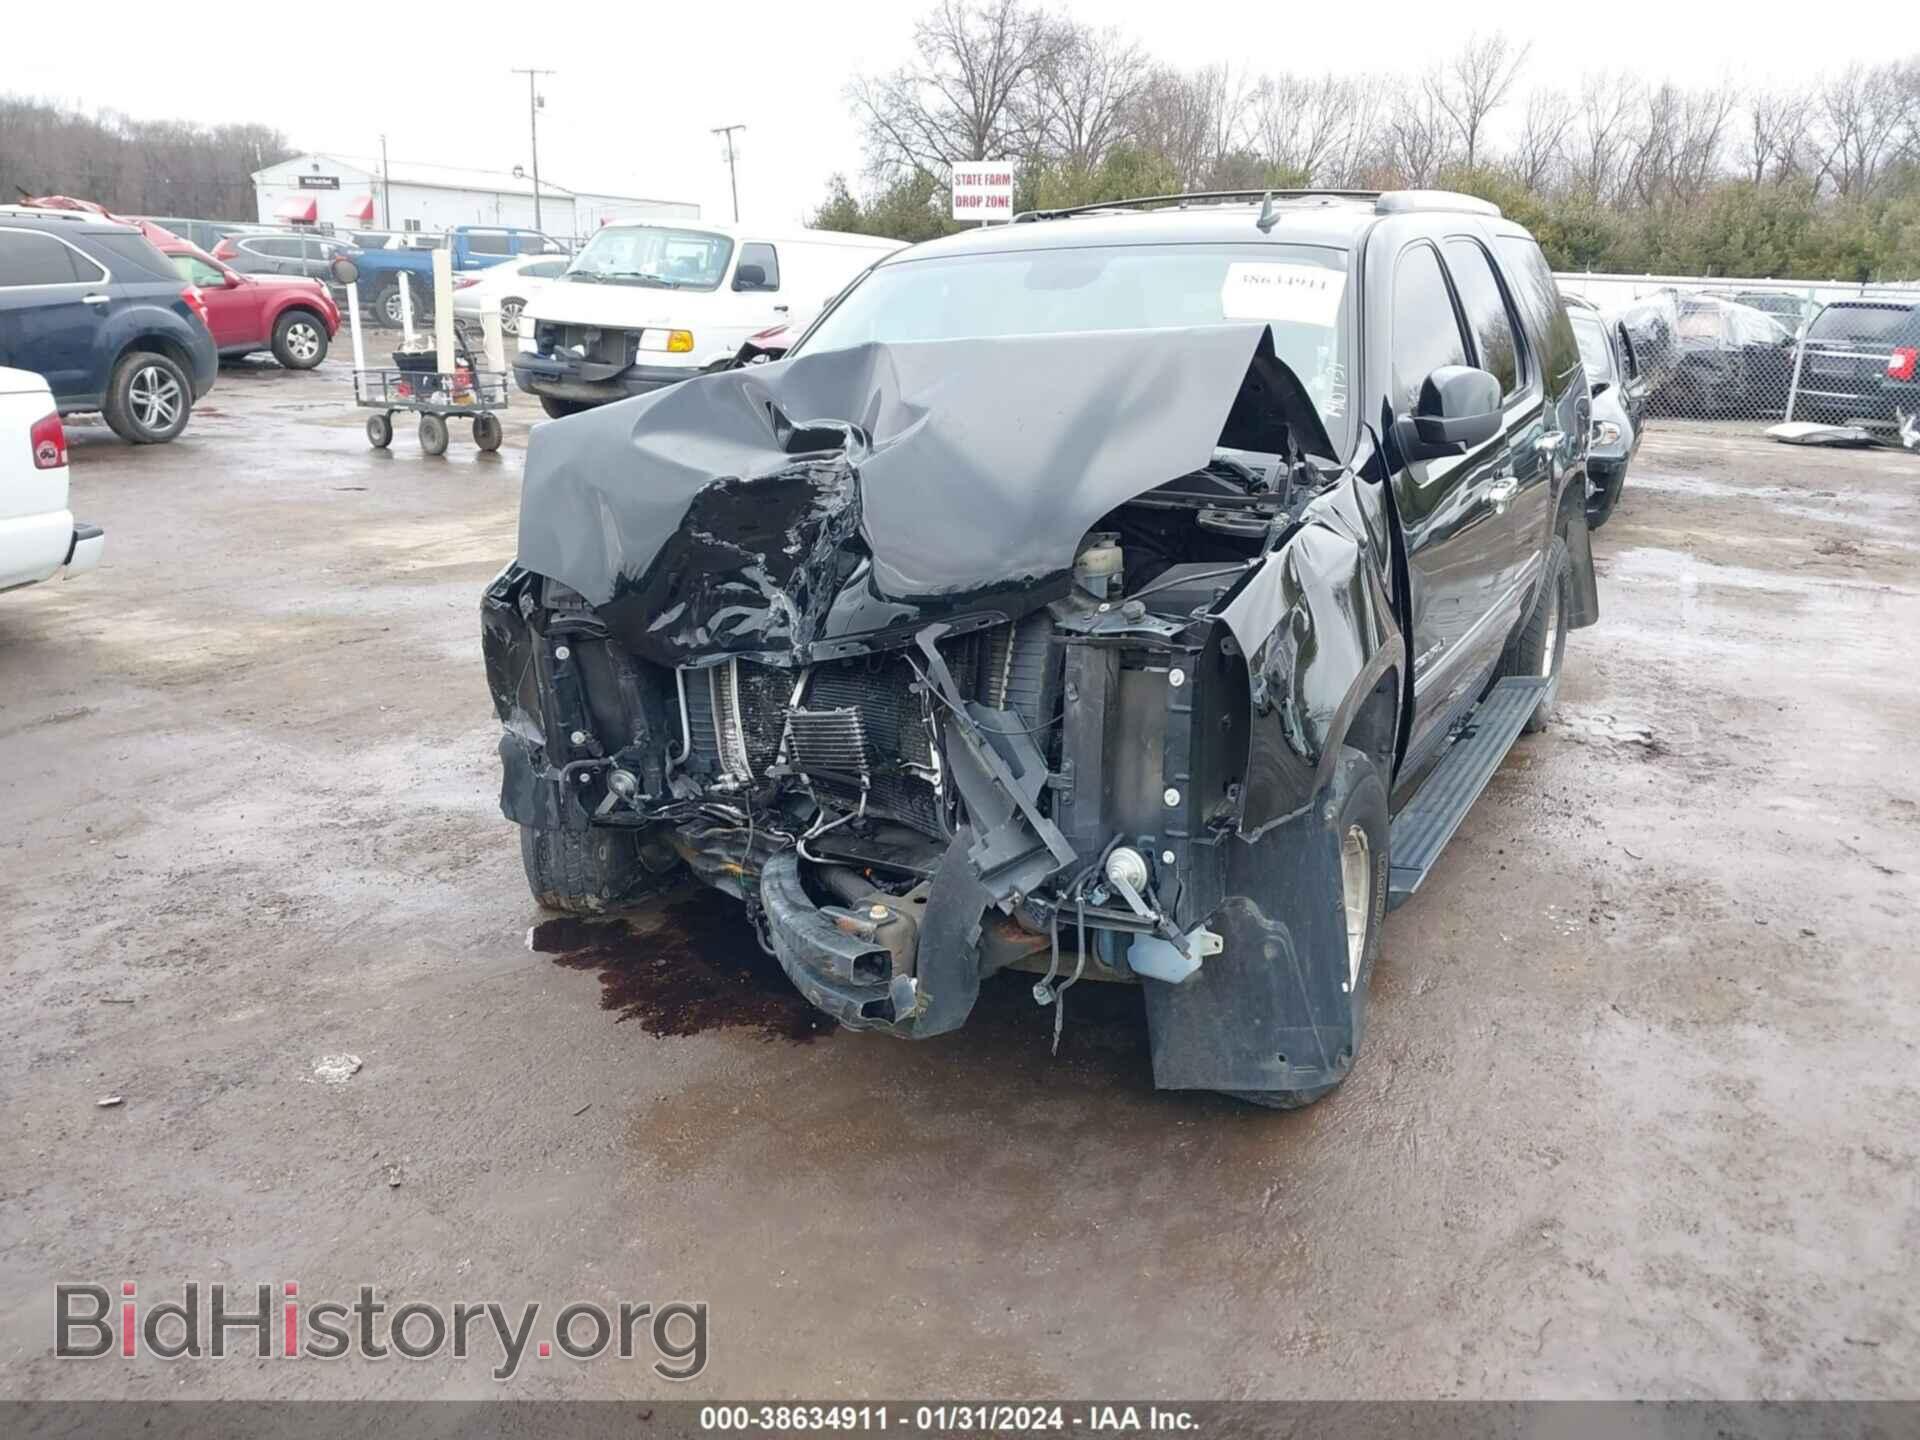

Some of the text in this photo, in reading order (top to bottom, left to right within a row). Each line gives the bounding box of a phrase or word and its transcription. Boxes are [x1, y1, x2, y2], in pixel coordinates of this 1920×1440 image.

[955, 173, 1010, 186] STATE FARM
[955, 195, 1010, 208] DROP ZONE
